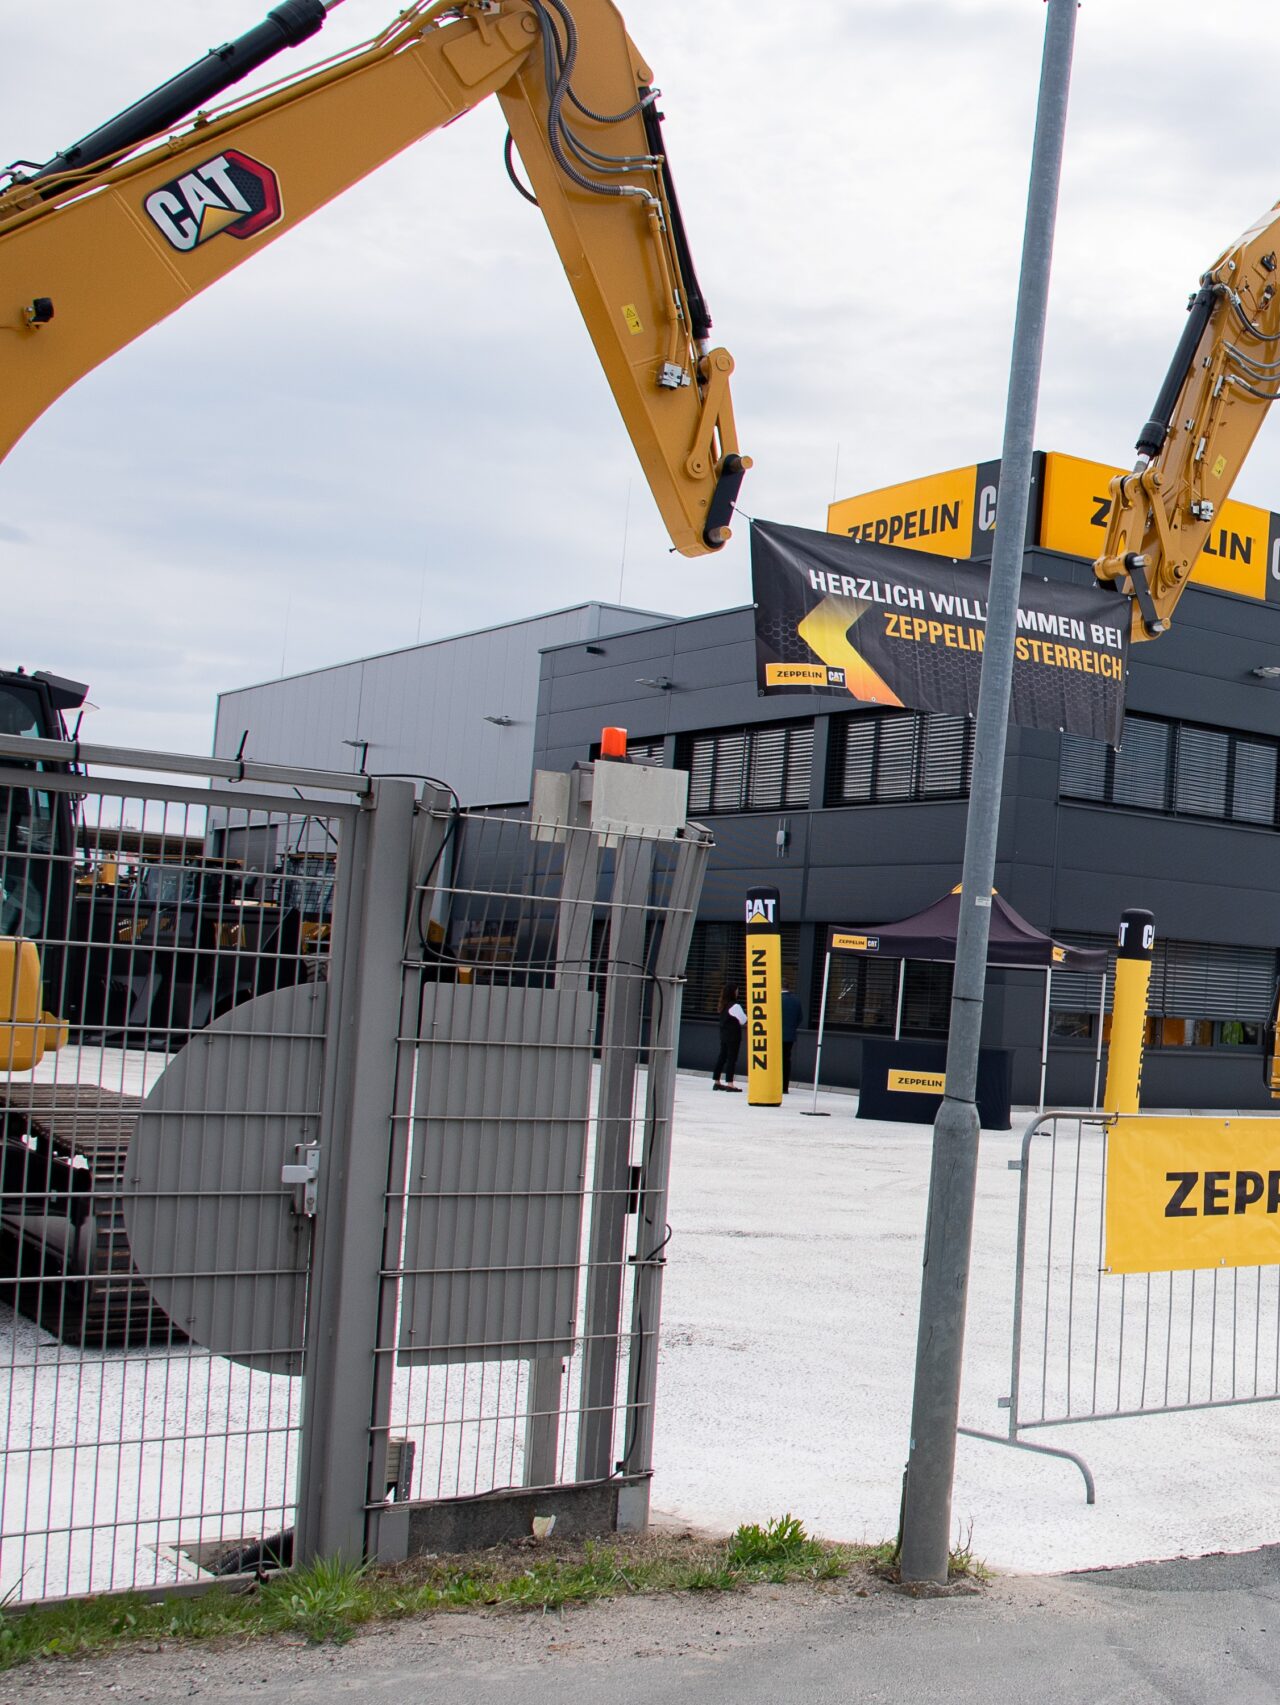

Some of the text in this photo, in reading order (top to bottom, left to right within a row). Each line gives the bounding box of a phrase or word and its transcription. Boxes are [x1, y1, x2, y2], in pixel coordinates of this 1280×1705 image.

[146, 156, 252, 250] CAT
[1090, 496, 1252, 564] ZLIN
[808, 569, 1122, 649] HERZLICH WILLMMEN BEI
[777, 670, 845, 682] ZEPPELIN CAT
[1015, 637, 1122, 681] STERREICH
[839, 938, 878, 948] ZEPPELIN CAT
[752, 949, 767, 1070] ZEPPELIN
[898, 1077, 942, 1087] ZEPPELIN
